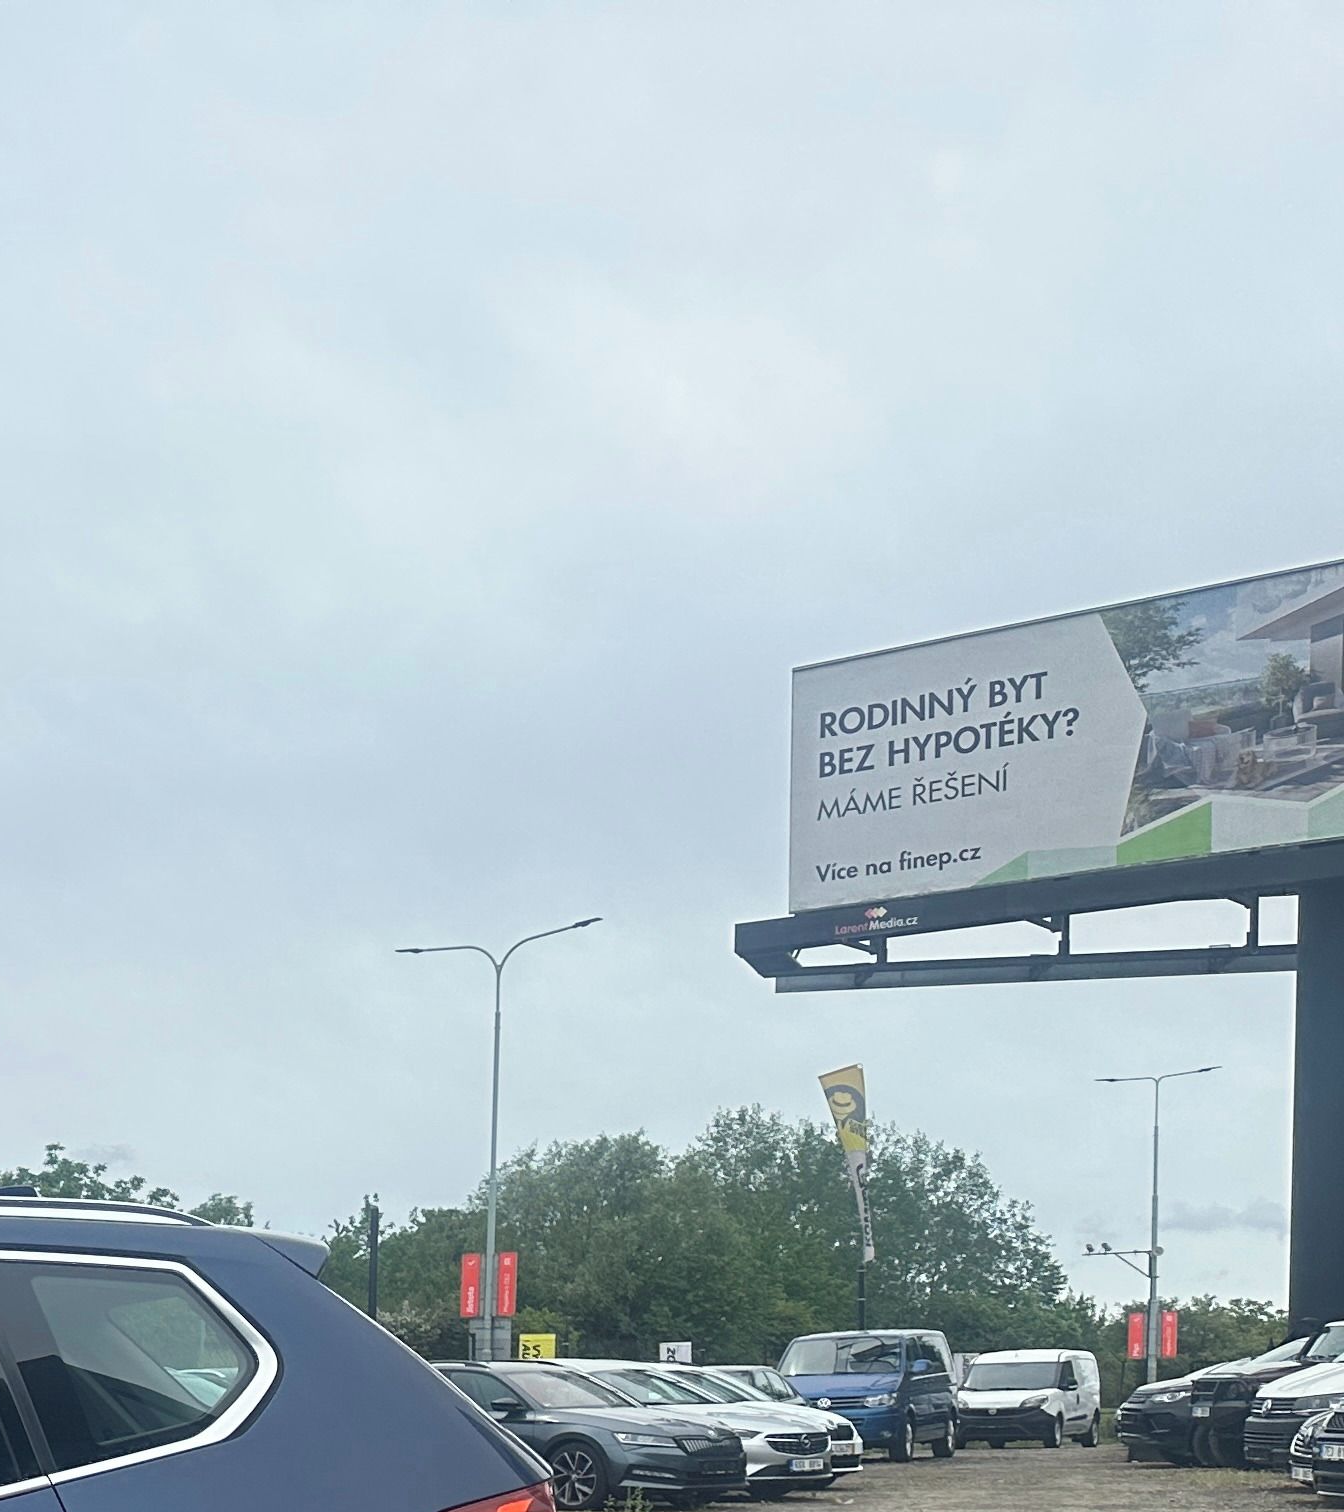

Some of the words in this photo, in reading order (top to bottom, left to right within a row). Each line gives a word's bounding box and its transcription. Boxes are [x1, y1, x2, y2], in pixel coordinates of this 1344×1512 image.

[819, 677, 977, 739] RODINNÝ
[989, 671, 1048, 708] BYT
[819, 744, 875, 778] BEZ
[888, 707, 1080, 767] HYPOTÉKY?
[816, 787, 902, 821] MÁME
[912, 762, 1010, 806] ŘEŠENÍ
[816, 863, 858, 882] Více
[865, 859, 892, 876] na
[899, 846, 982, 871] finep.cz
[834, 916, 919, 935] LarentMedia.cz
